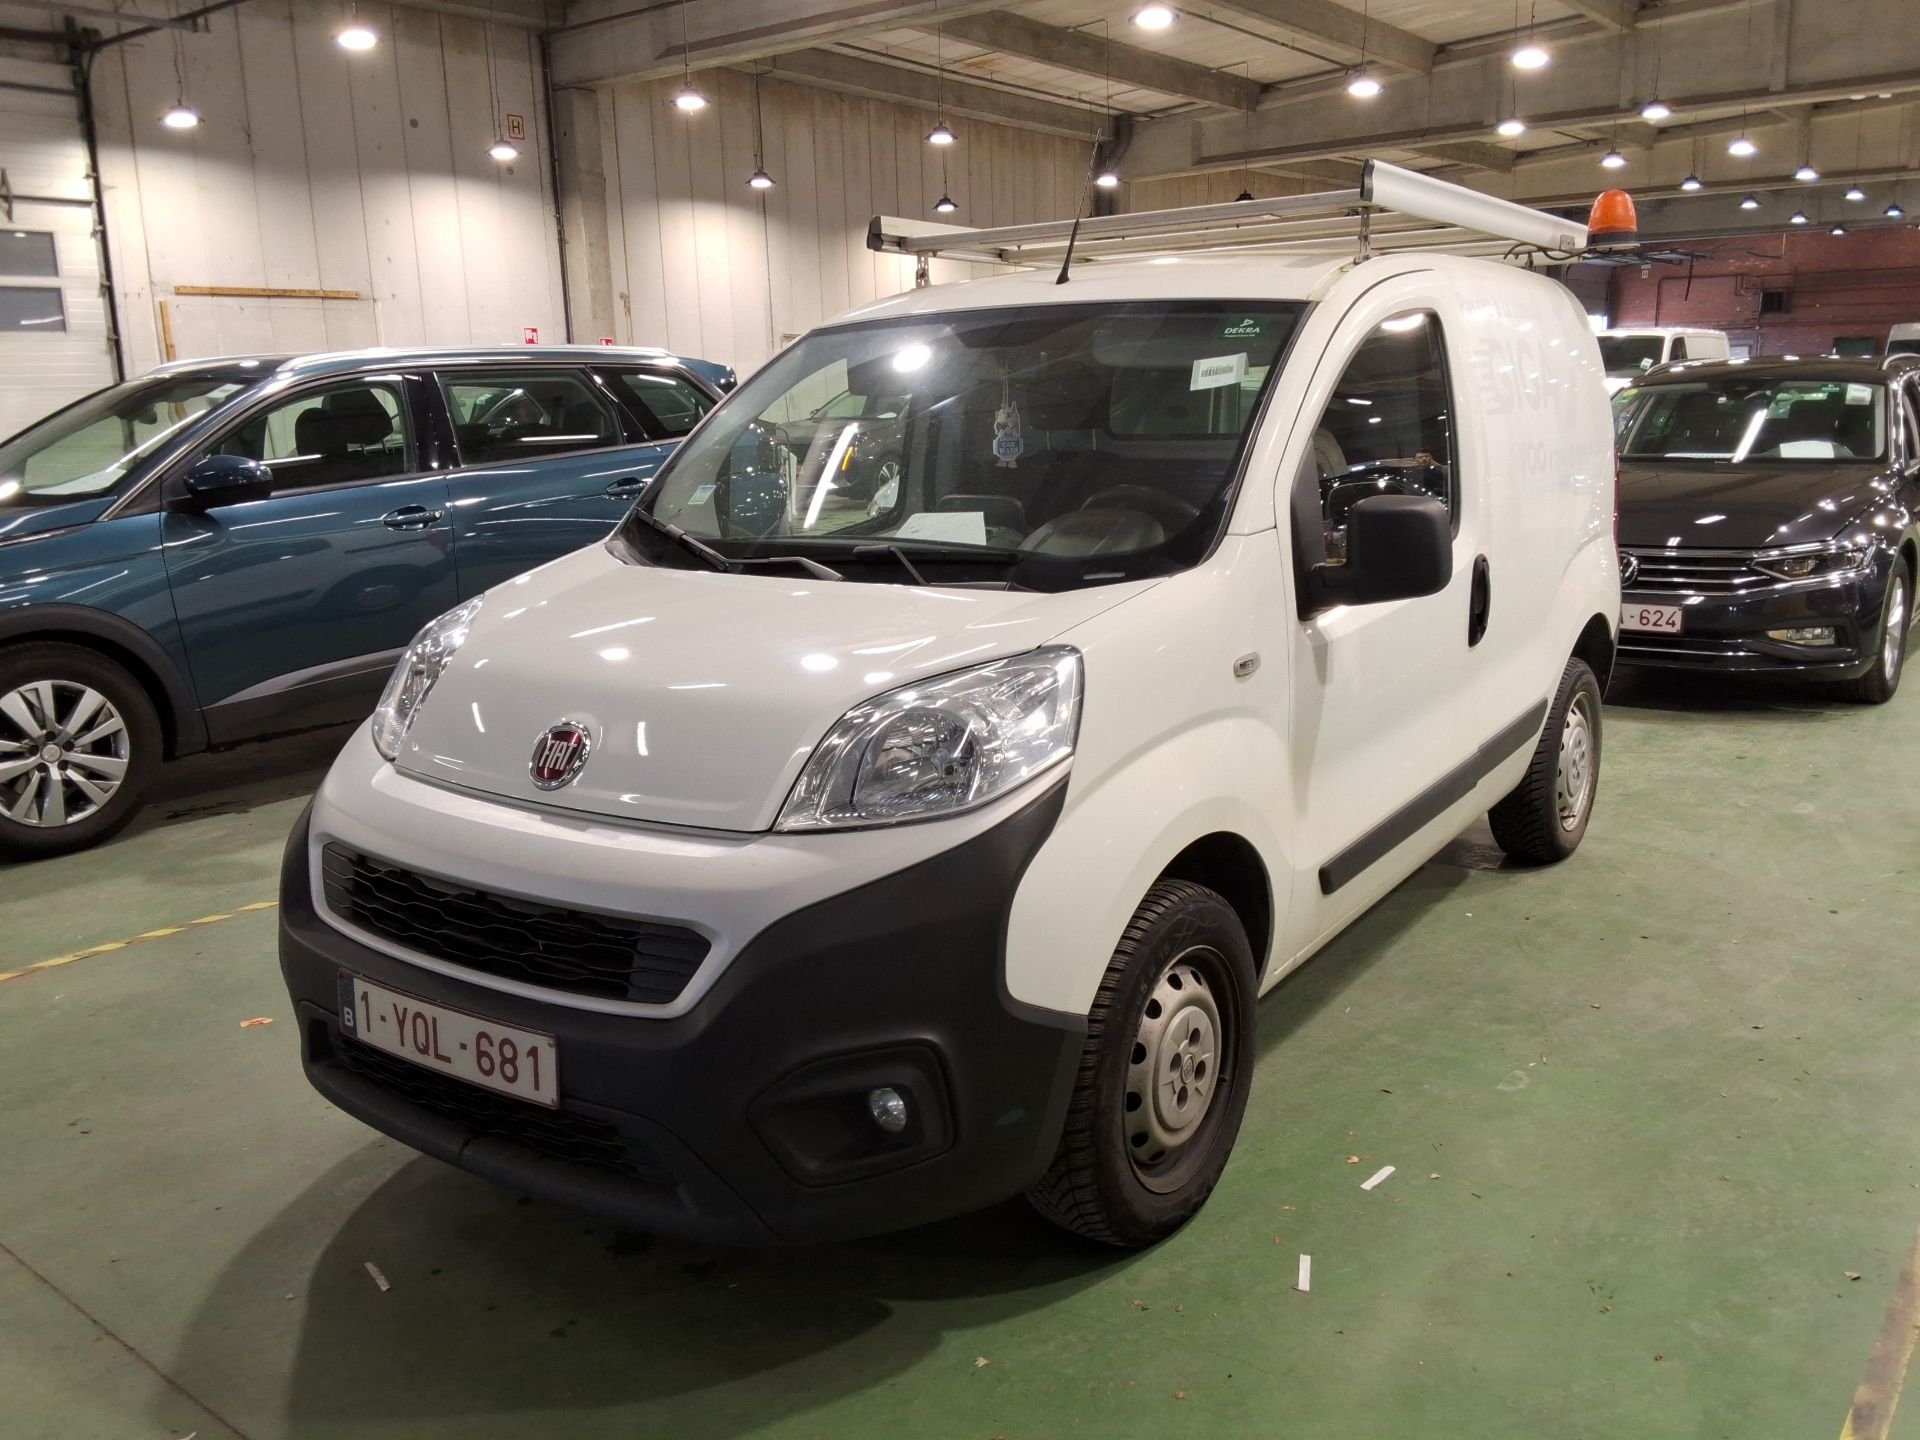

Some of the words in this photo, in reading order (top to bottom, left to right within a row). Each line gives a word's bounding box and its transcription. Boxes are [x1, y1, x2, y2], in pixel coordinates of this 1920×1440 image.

[511, 119, 521, 135] H
[999, 447, 1019, 455] WASH
[1620, 608, 1677, 628] -624
[539, 740, 577, 770] FIAT
[344, 1007, 354, 1027] B
[360, 990, 540, 1091] 1-YQL-681
